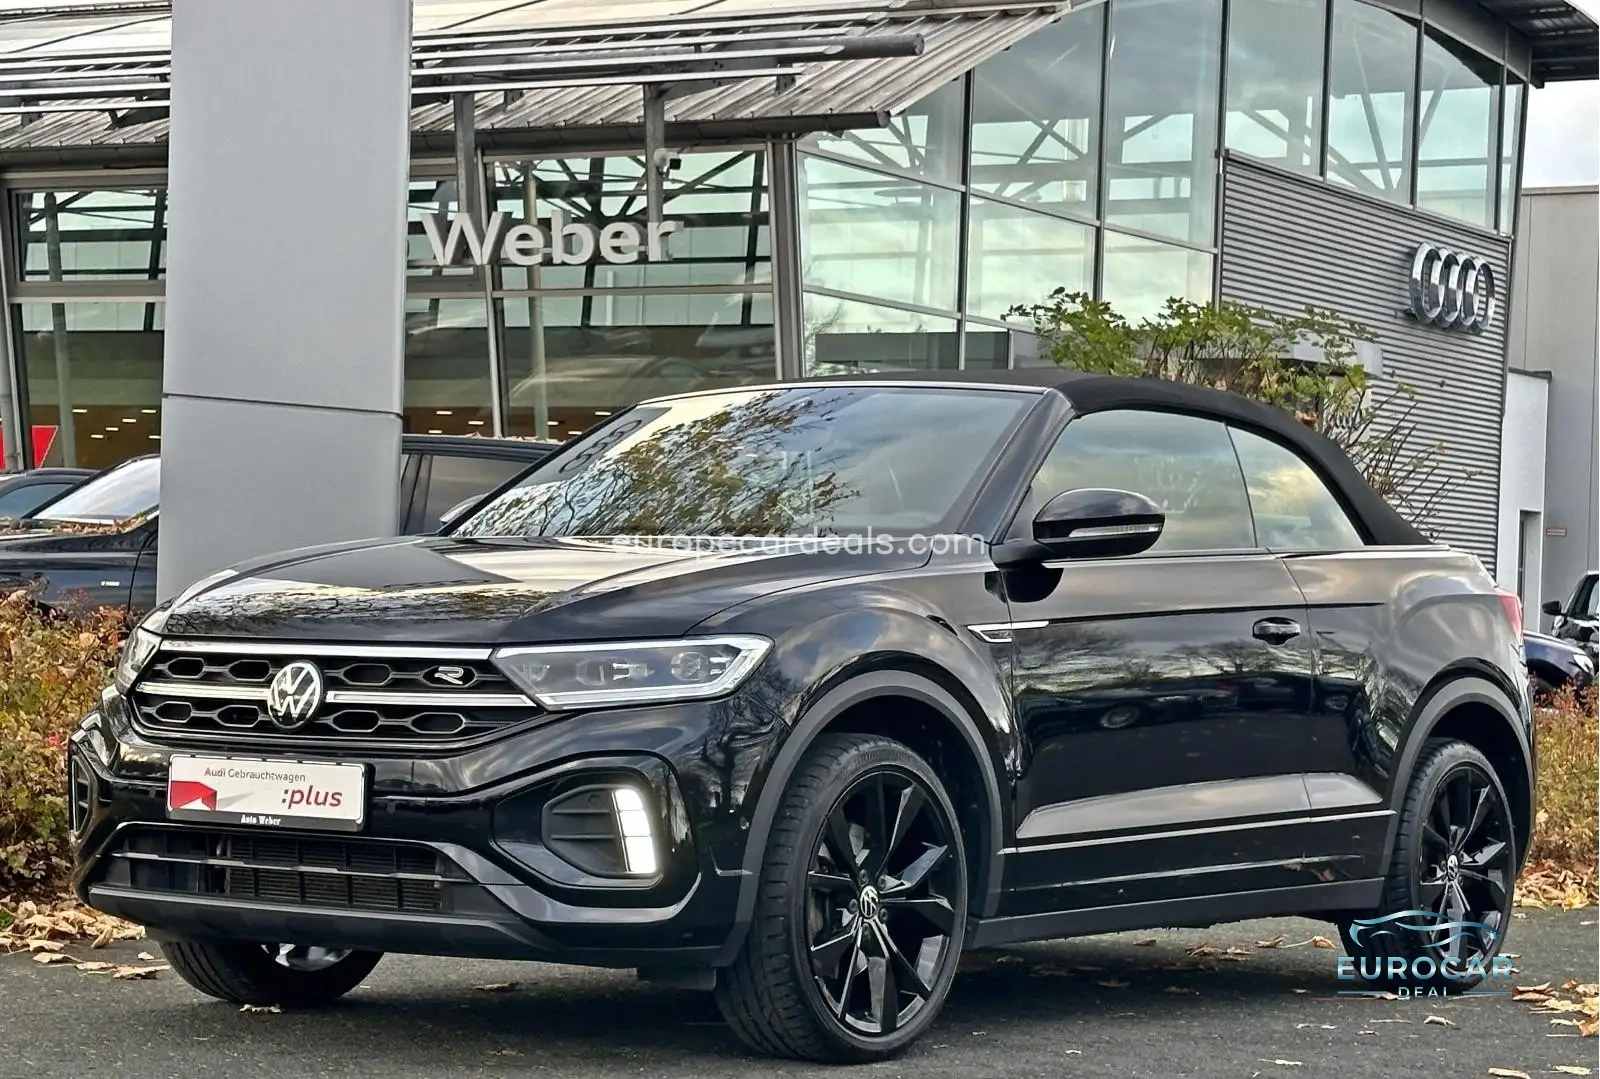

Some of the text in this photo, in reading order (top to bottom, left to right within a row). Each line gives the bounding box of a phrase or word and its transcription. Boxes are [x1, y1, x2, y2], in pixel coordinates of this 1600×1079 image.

[420, 209, 682, 266] Weber
[204, 767, 306, 783] Audi Gebrauchtwagen
[240, 814, 281, 826] Auto Weber
